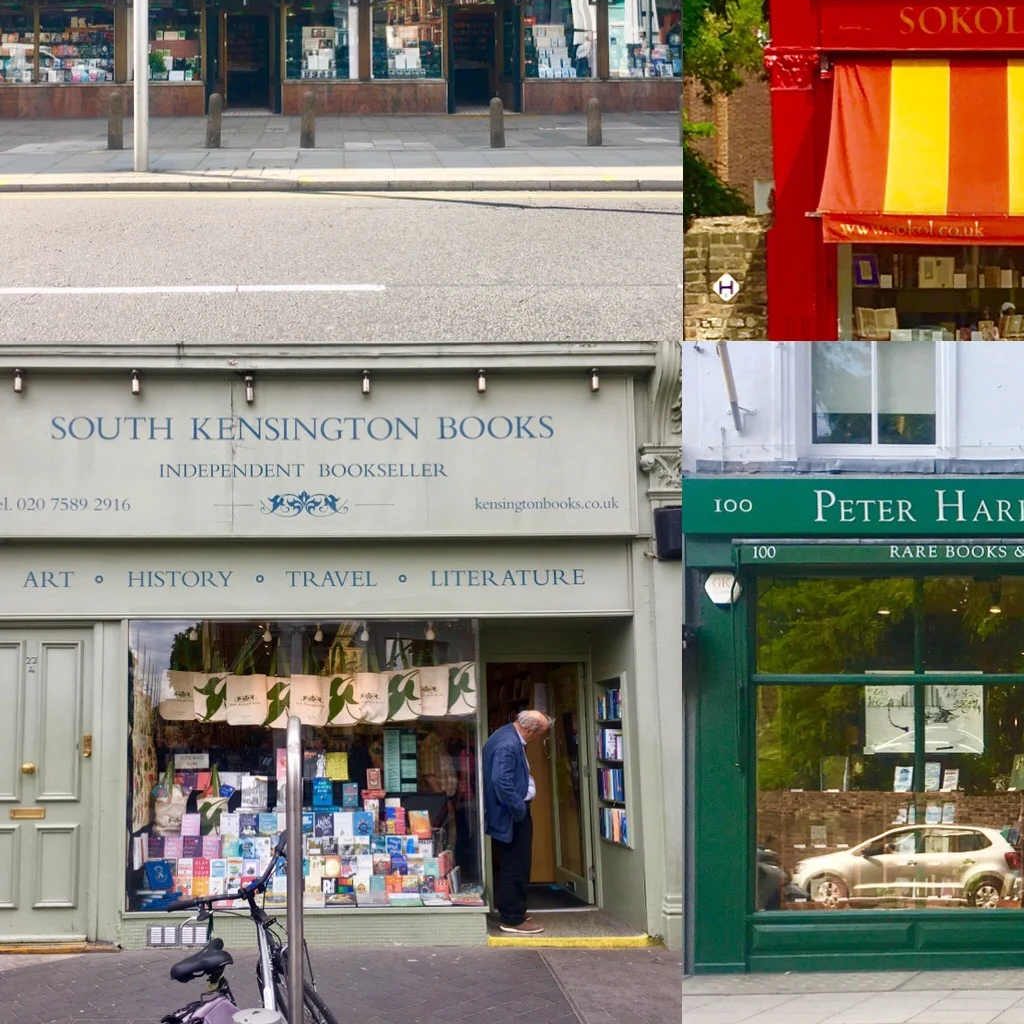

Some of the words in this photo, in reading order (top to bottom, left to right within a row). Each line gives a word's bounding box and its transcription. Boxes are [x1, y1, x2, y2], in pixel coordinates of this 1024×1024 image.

[839, 219, 985, 239] www.sokol.co.uk
[51, 416, 174, 441] SOUTH
[190, 416, 420, 442] KENSINGTON
[437, 414, 555, 440] BOOKS
[159, 463, 305, 478] INDEPENDENT
[319, 462, 449, 478] BOOKSELLER
[16, 497, 46, 512] 020
[50, 497, 88, 513] 7589
[93, 496, 131, 512] 2916
[474, 497, 619, 514] kensingtonbooks.co.uk
[813, 489, 917, 522] PETER
[752, 545, 777, 559] 100
[889, 545, 938, 559] RARE
[945, 545, 1008, 558] BOOKS
[22, 570, 76, 588] ART
[127, 570, 235, 588] HISTORY
[286, 570, 378, 588] TRAVEL
[430, 569, 586, 587] LITERATURE
